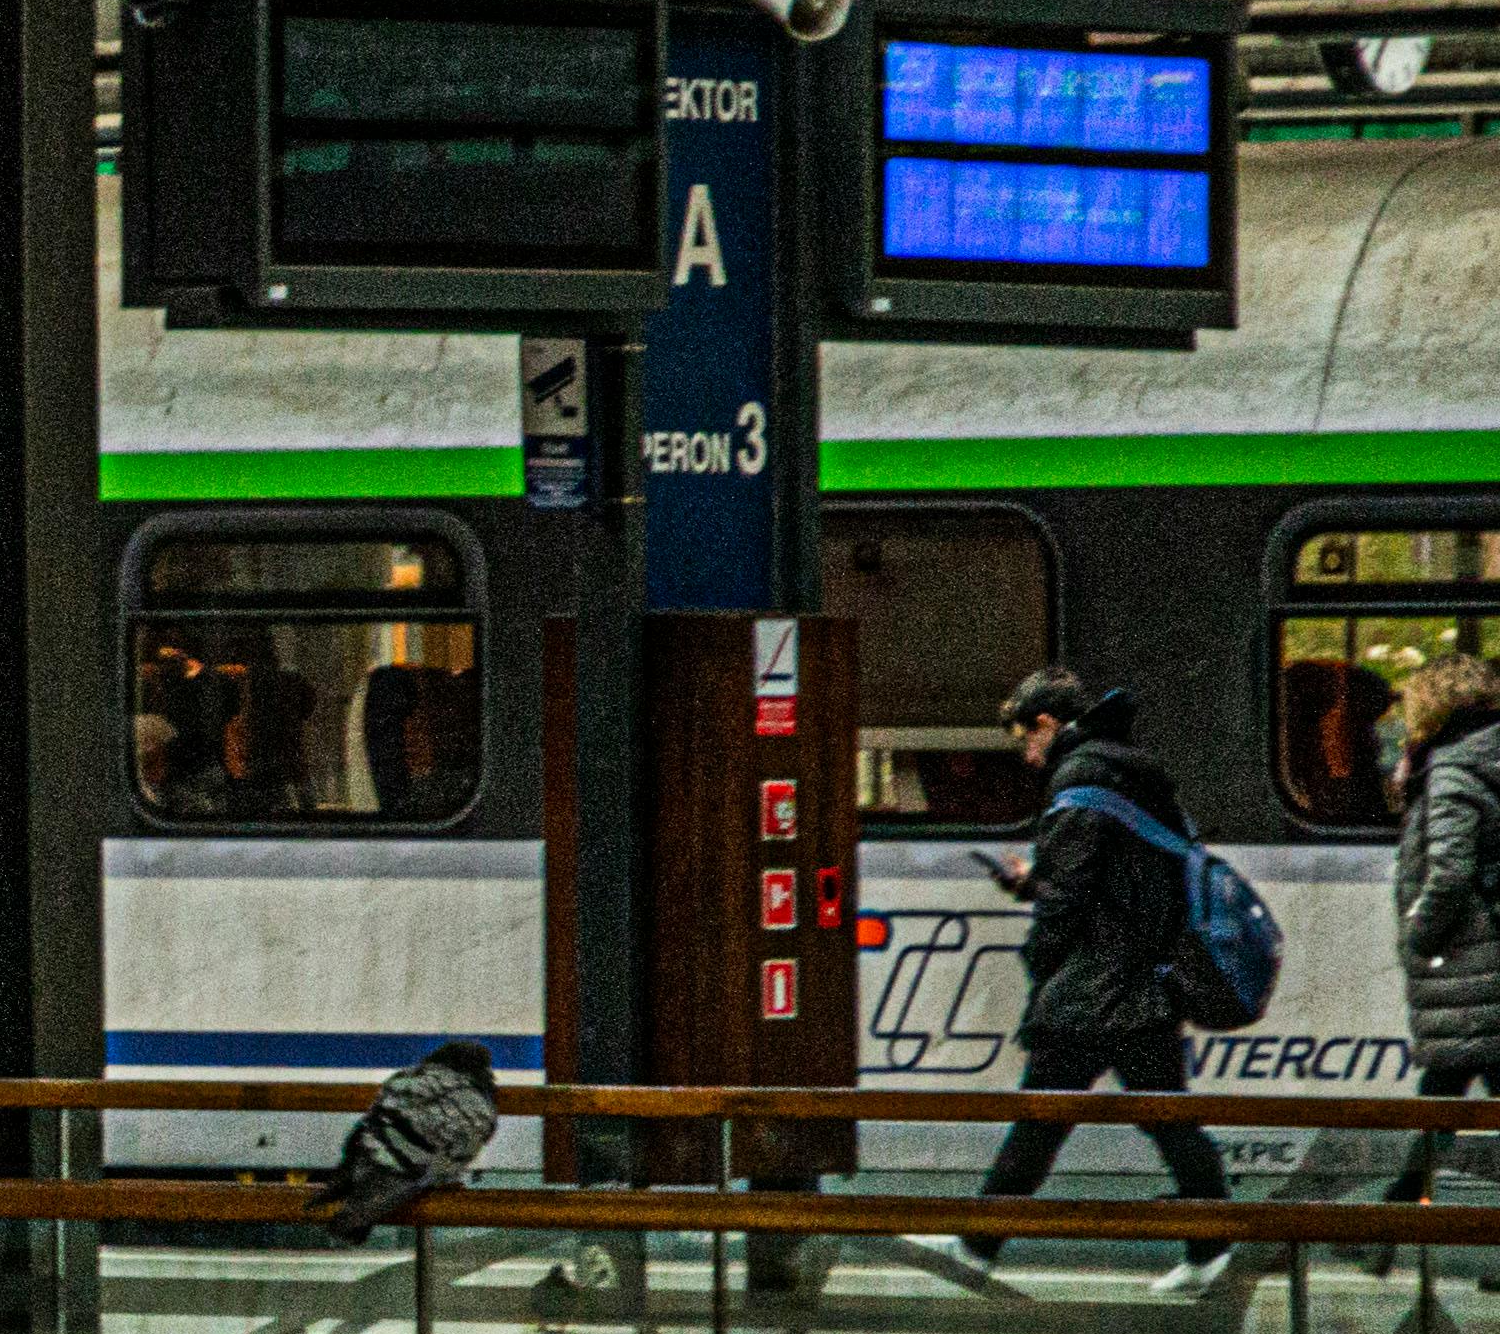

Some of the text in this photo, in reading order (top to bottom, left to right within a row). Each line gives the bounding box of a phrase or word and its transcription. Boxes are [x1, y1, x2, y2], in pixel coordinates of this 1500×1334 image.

[666, 76, 759, 123] EKTOR
[672, 183, 728, 287] A
[736, 401, 768, 476] 3
[1181, 1035, 1415, 1081] NTERCITY
